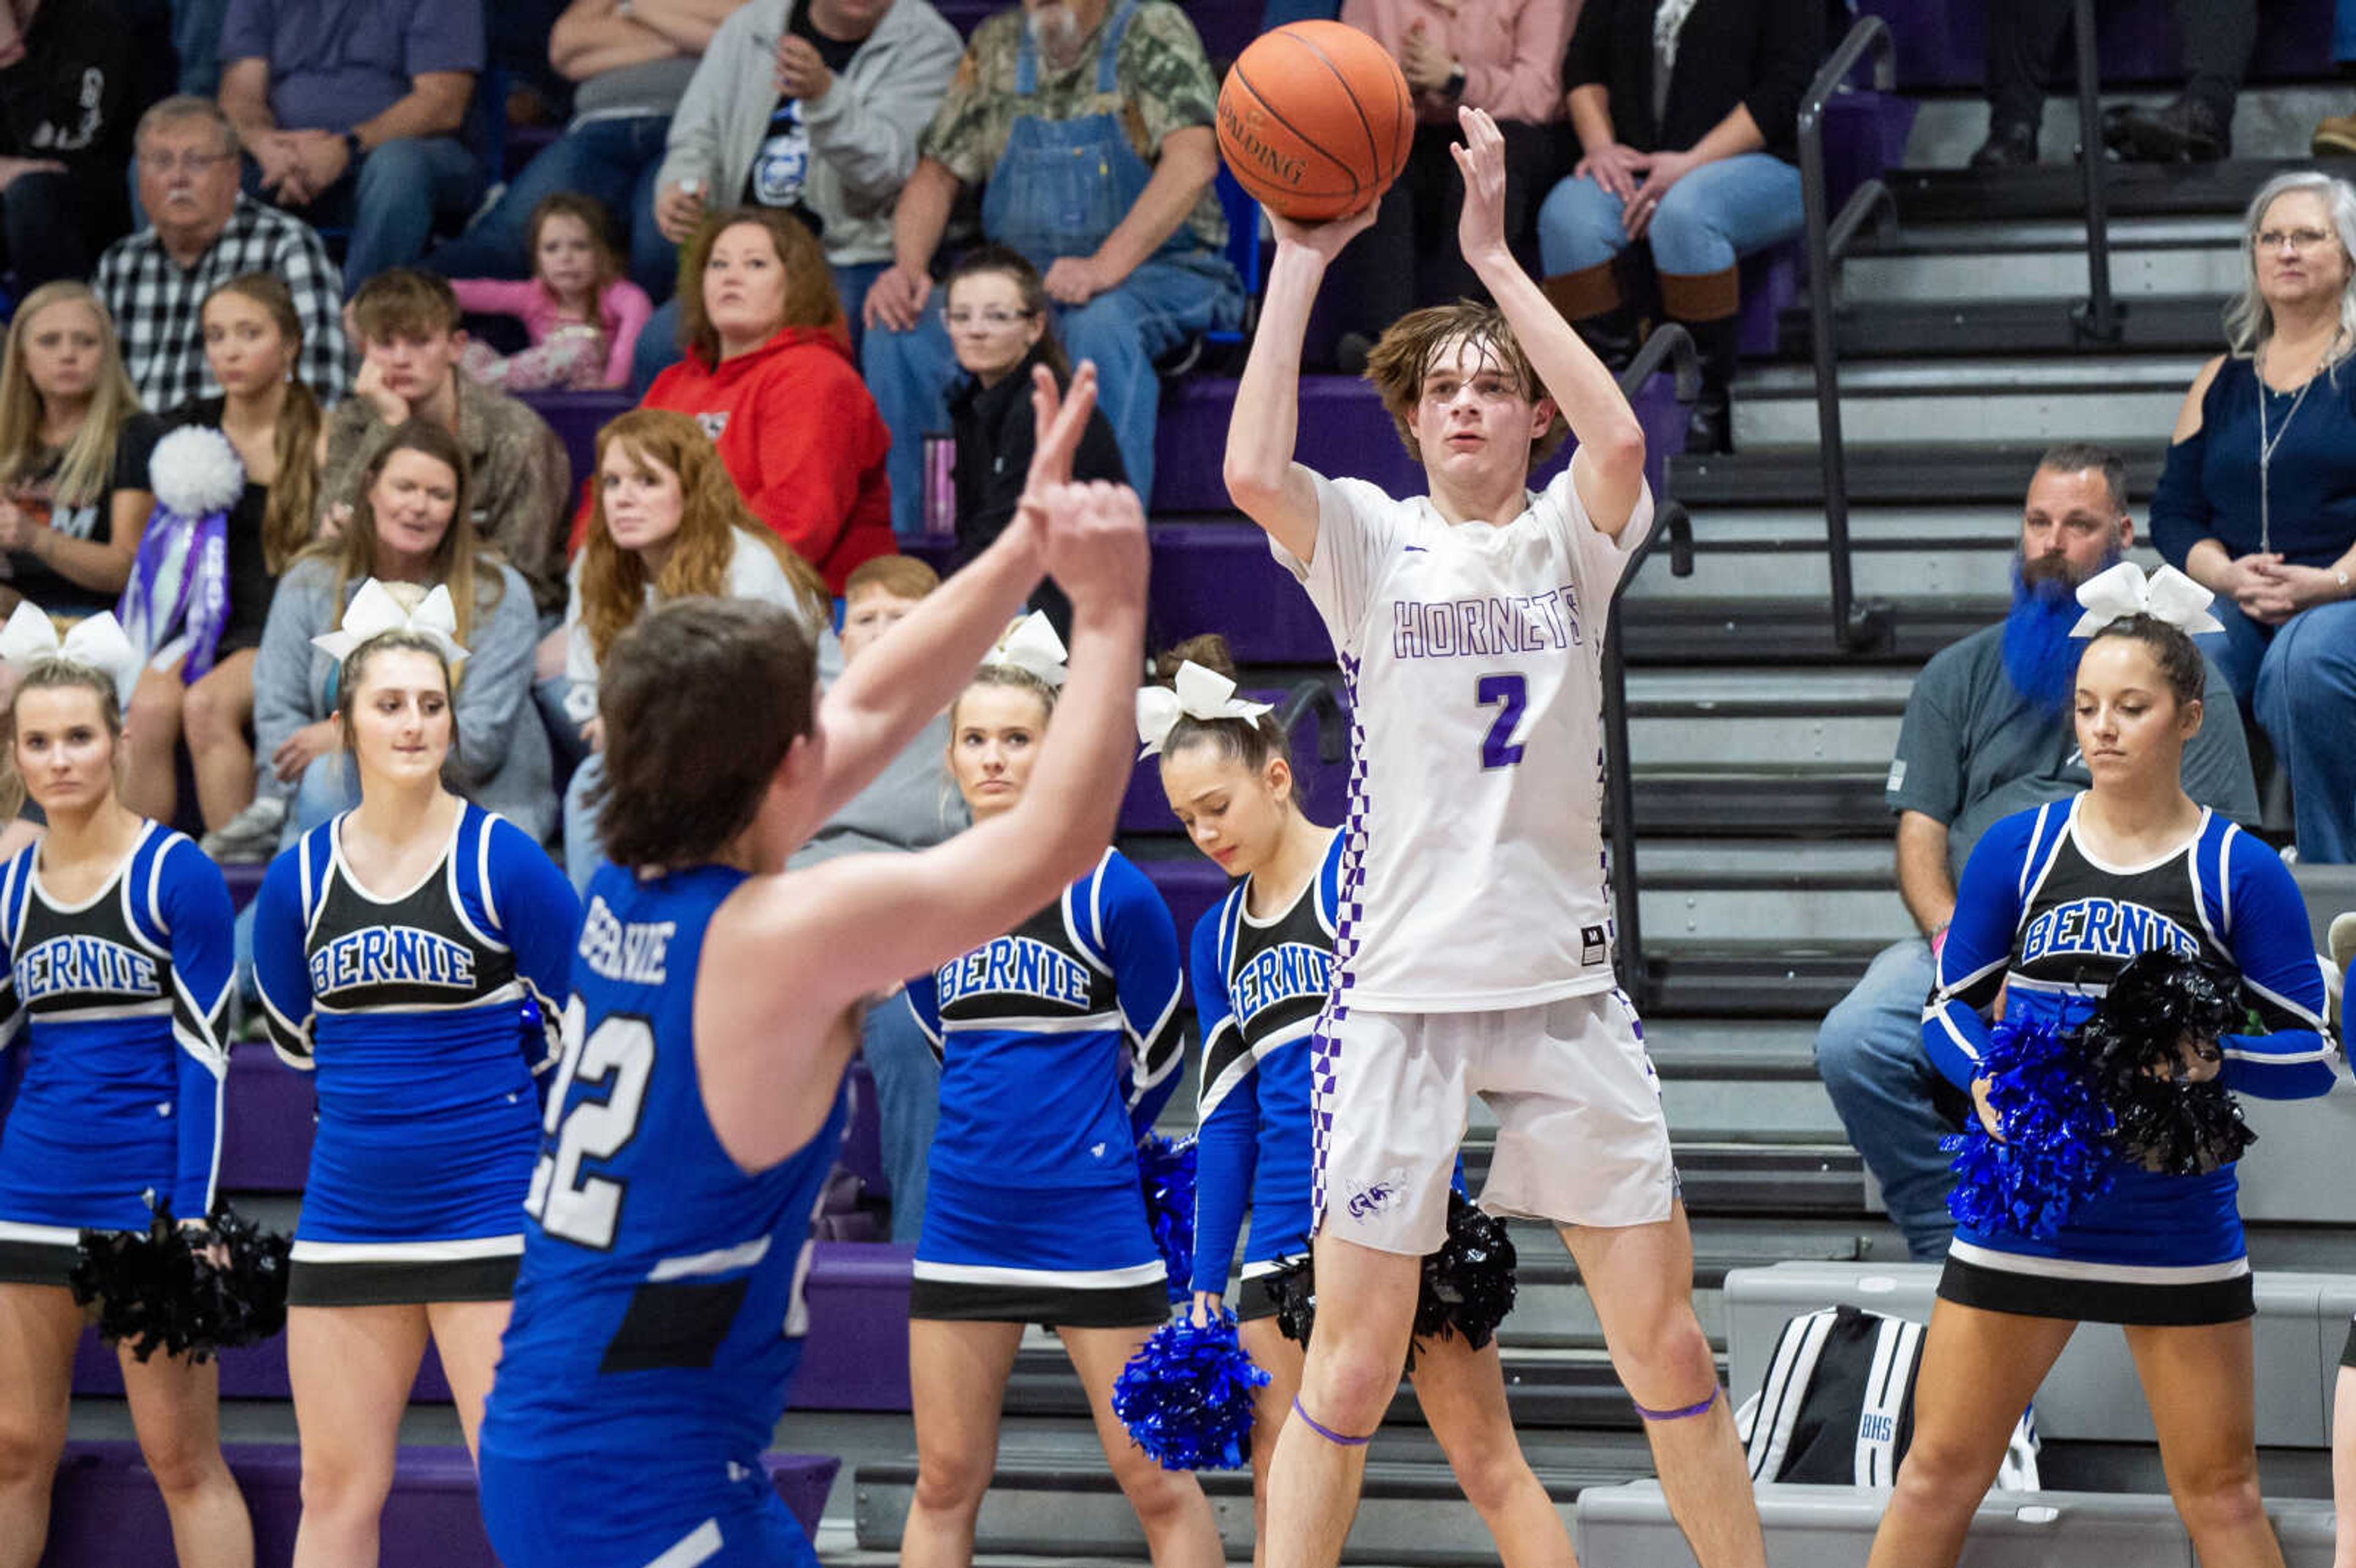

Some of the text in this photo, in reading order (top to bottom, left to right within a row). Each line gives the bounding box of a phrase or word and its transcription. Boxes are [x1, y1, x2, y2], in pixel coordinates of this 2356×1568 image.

[1475, 672, 1528, 771] 2
[309, 924, 477, 998] BERNIE
[1588, 930, 1599, 943] M
[2022, 897, 2201, 966] BERNIE
[937, 935, 1091, 1012] BERNIE
[1861, 1413, 1892, 1442] BHS
